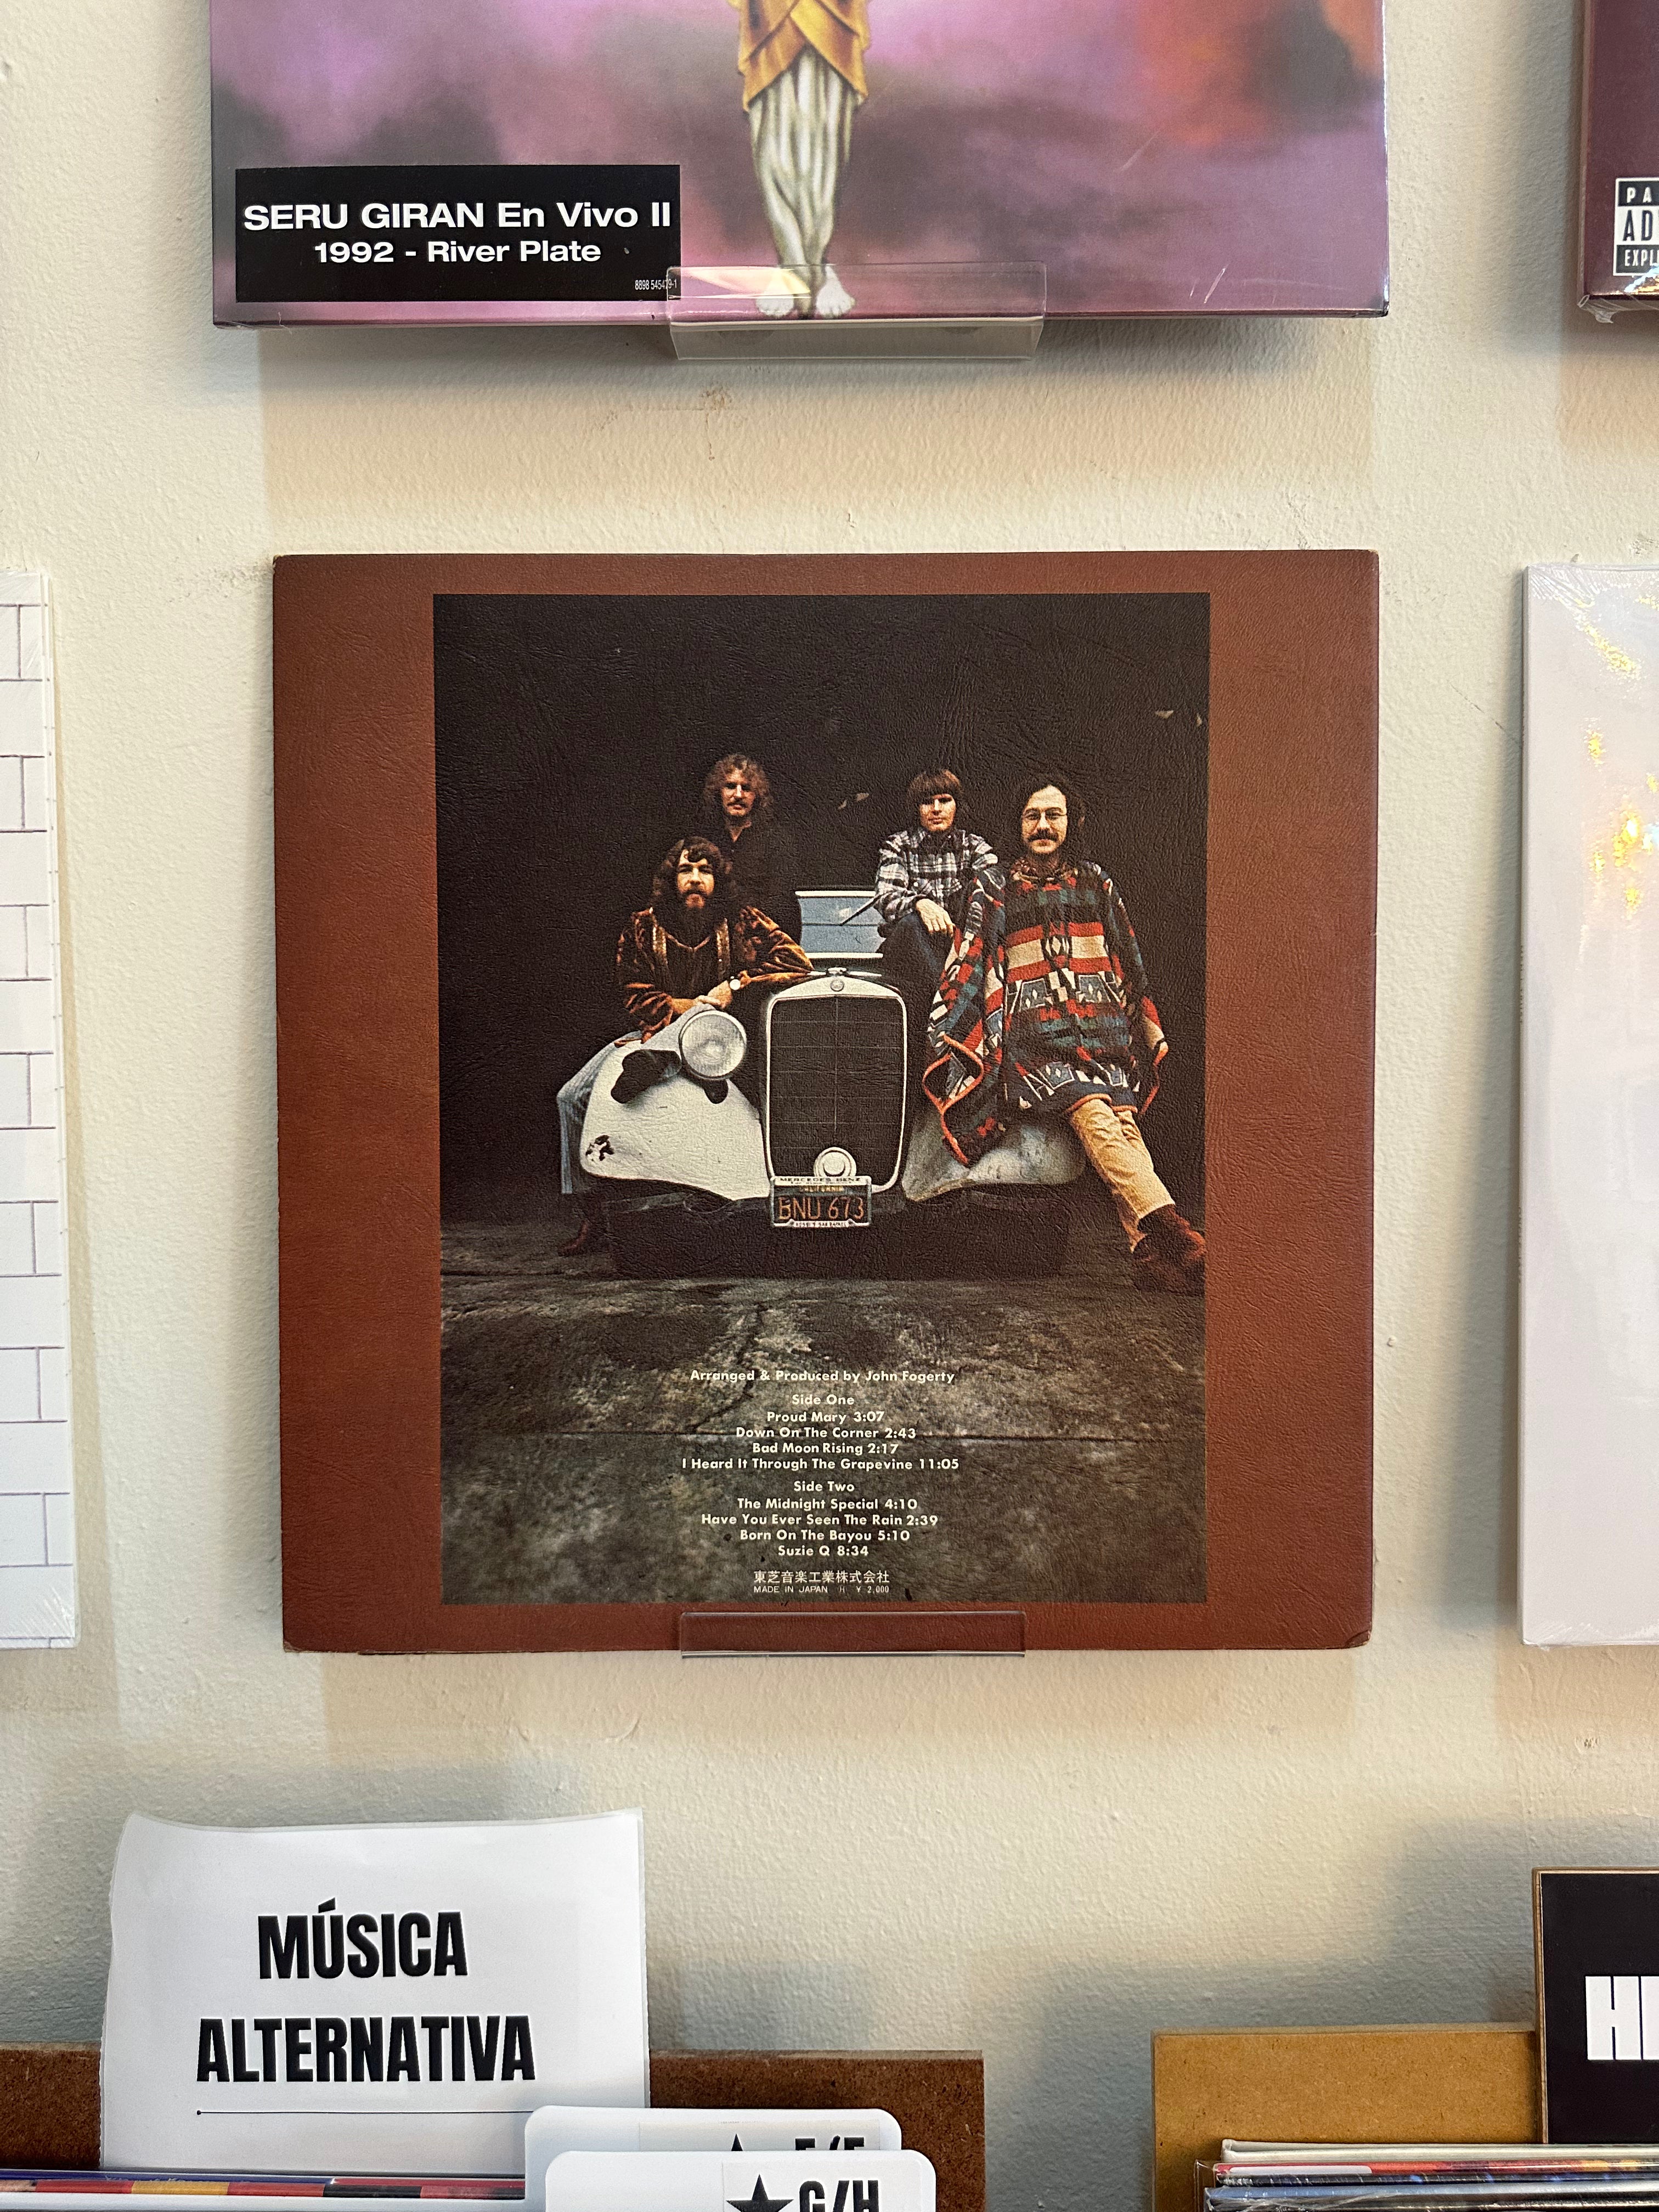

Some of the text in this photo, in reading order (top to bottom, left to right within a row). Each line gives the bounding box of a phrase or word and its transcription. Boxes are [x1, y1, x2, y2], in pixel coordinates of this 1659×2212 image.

[244, 202, 670, 232] SERU GIRAN En Vivo II
[1623, 210, 1658, 241] AD
[314, 242, 394, 264] 1992
[428, 241, 510, 262] River
[521, 240, 601, 262] Plate
[635, 280, 650, 290] 8898
[778, 1197, 865, 1220] BNU 673
[690, 1370, 955, 1384] Arranged & Produced by John Fogerty
[792, 1394, 855, 1405] Side One
[767, 1411, 885, 1424] Proud Mary 3:07
[736, 1427, 916, 1438] Down On The Corner 2:43
[753, 1443, 899, 1455] Bad Moon Rising 2:17
[682, 1458, 959, 1471] I Heard It Through The Grapevine 11:05
[794, 1481, 855, 1492] Side Two
[737, 1498, 917, 1511] The Midnight Special 4:10
[702, 1514, 938, 1526] Have You Ever Seen The Rain 2:39
[740, 1530, 910, 1542] Born On The Bayou 5:10
[778, 1545, 868, 1556] Suzie Q 8:34
[754, 1570, 890, 1583] 東芝音楽工業株式会社
[258, 1897, 468, 1979] MÚSICA
[197, 2015, 536, 2083] ALTERNATIVA
